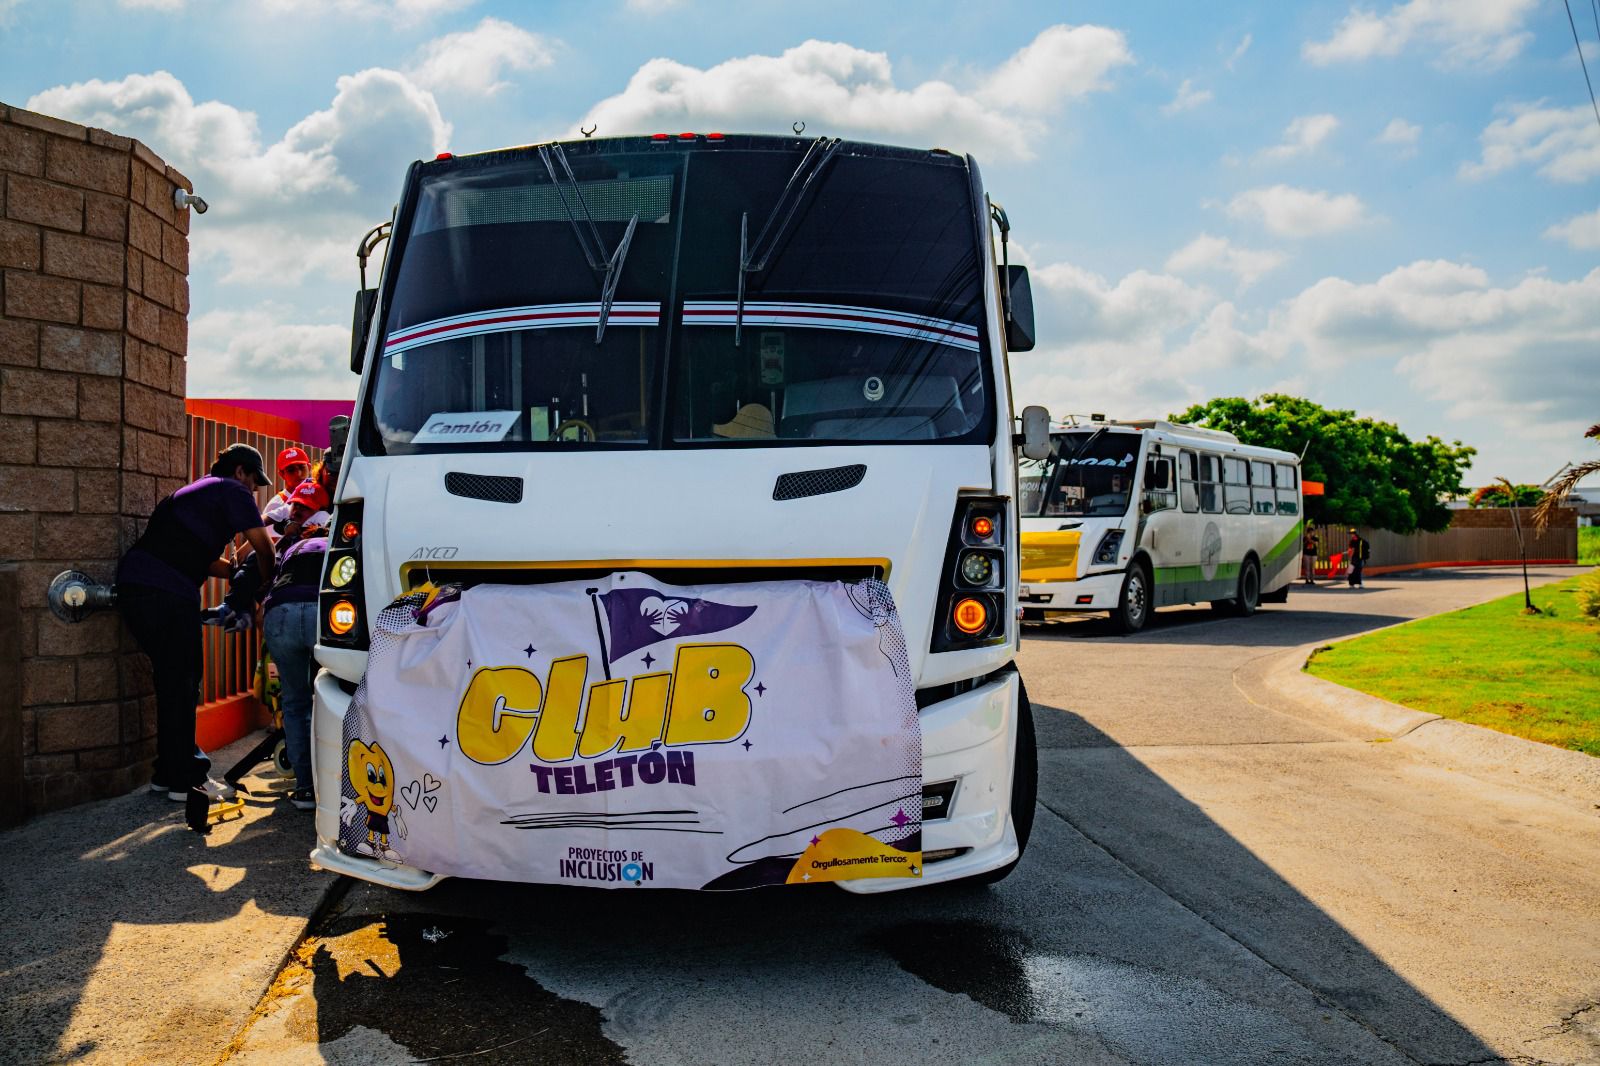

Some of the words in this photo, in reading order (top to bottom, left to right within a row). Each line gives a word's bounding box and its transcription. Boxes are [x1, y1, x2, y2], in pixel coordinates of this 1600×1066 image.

[428, 421, 502, 434] Camión
[530, 743, 697, 794] TELETÓN
[568, 847, 628, 862] PROYECTOS
[631, 851, 643, 861] DE
[811, 856, 879, 869] Orgullosamente
[880, 855, 907, 863] Tercos
